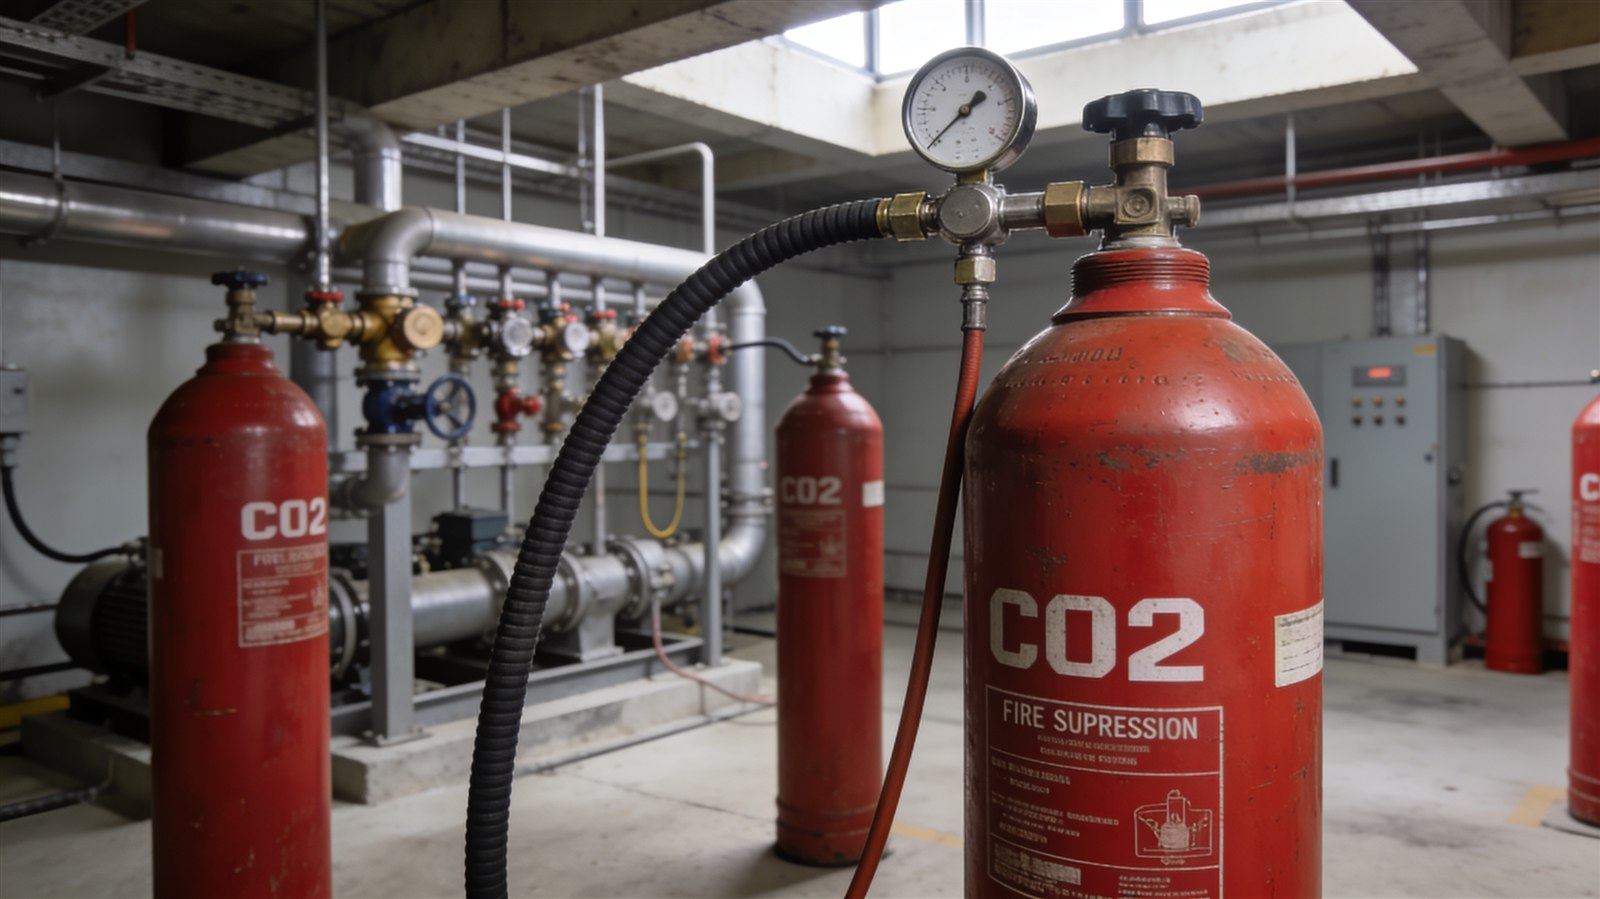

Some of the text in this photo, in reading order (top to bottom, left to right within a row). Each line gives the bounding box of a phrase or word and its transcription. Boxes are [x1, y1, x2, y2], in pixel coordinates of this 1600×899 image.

[780, 475, 842, 505] CO2
[1579, 472, 1600, 501] C
[240, 496, 327, 541] CO2
[989, 586, 1205, 682] CO2
[1003, 699, 1199, 740] FIRE SUPRESSION
